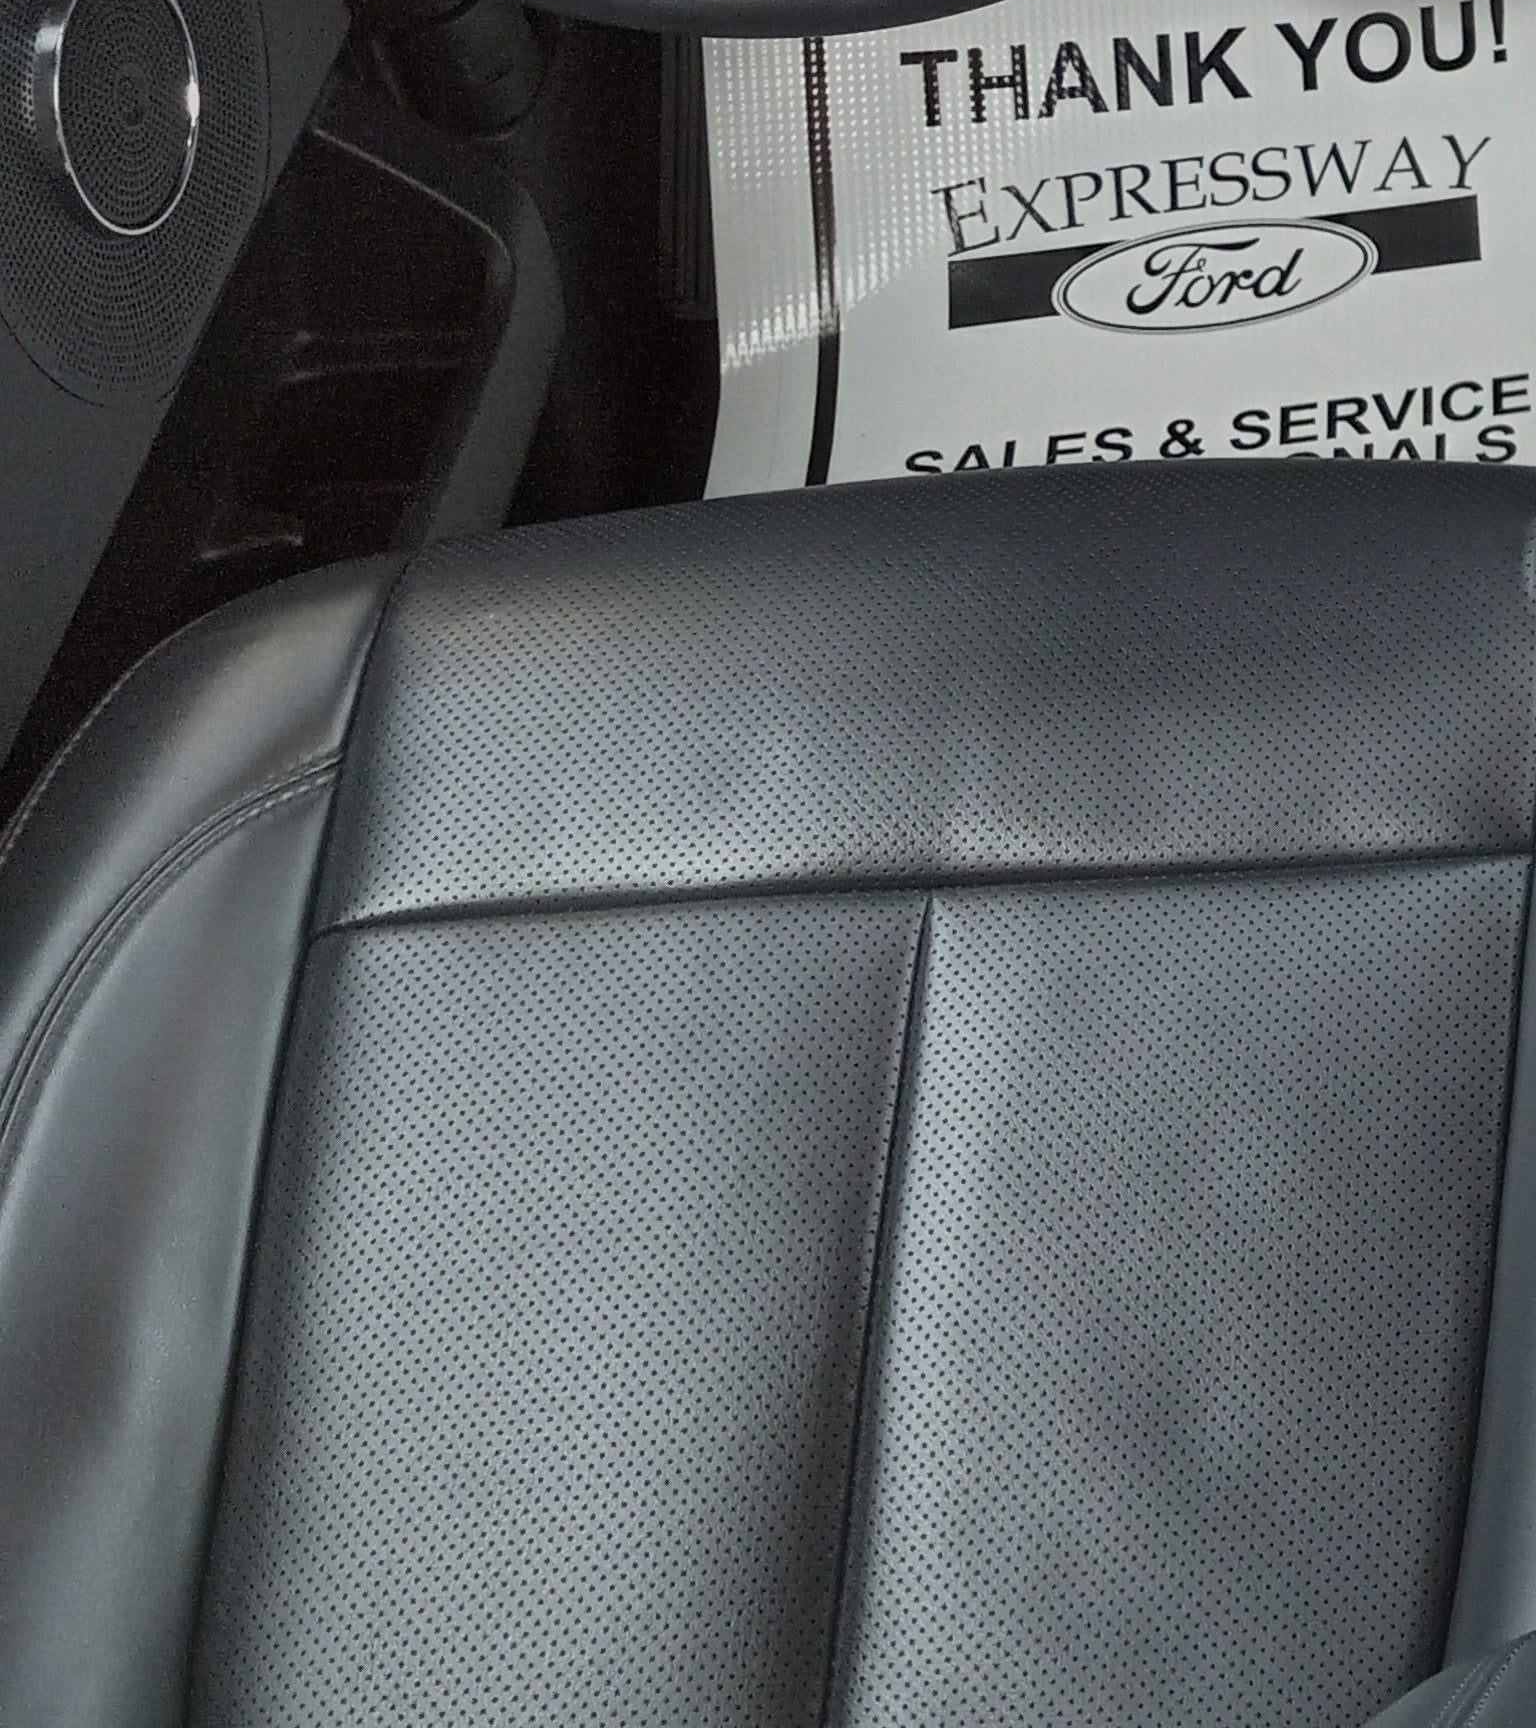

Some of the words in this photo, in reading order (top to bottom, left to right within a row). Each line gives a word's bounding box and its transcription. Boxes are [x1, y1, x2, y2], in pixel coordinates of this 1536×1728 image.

[900, 26, 1252, 127] THANK
[932, 134, 1492, 257] EXPRESSWAY
[1126, 237, 1305, 316] Ford
[1158, 418, 1206, 460] &
[1228, 372, 1533, 452] SERVICE
